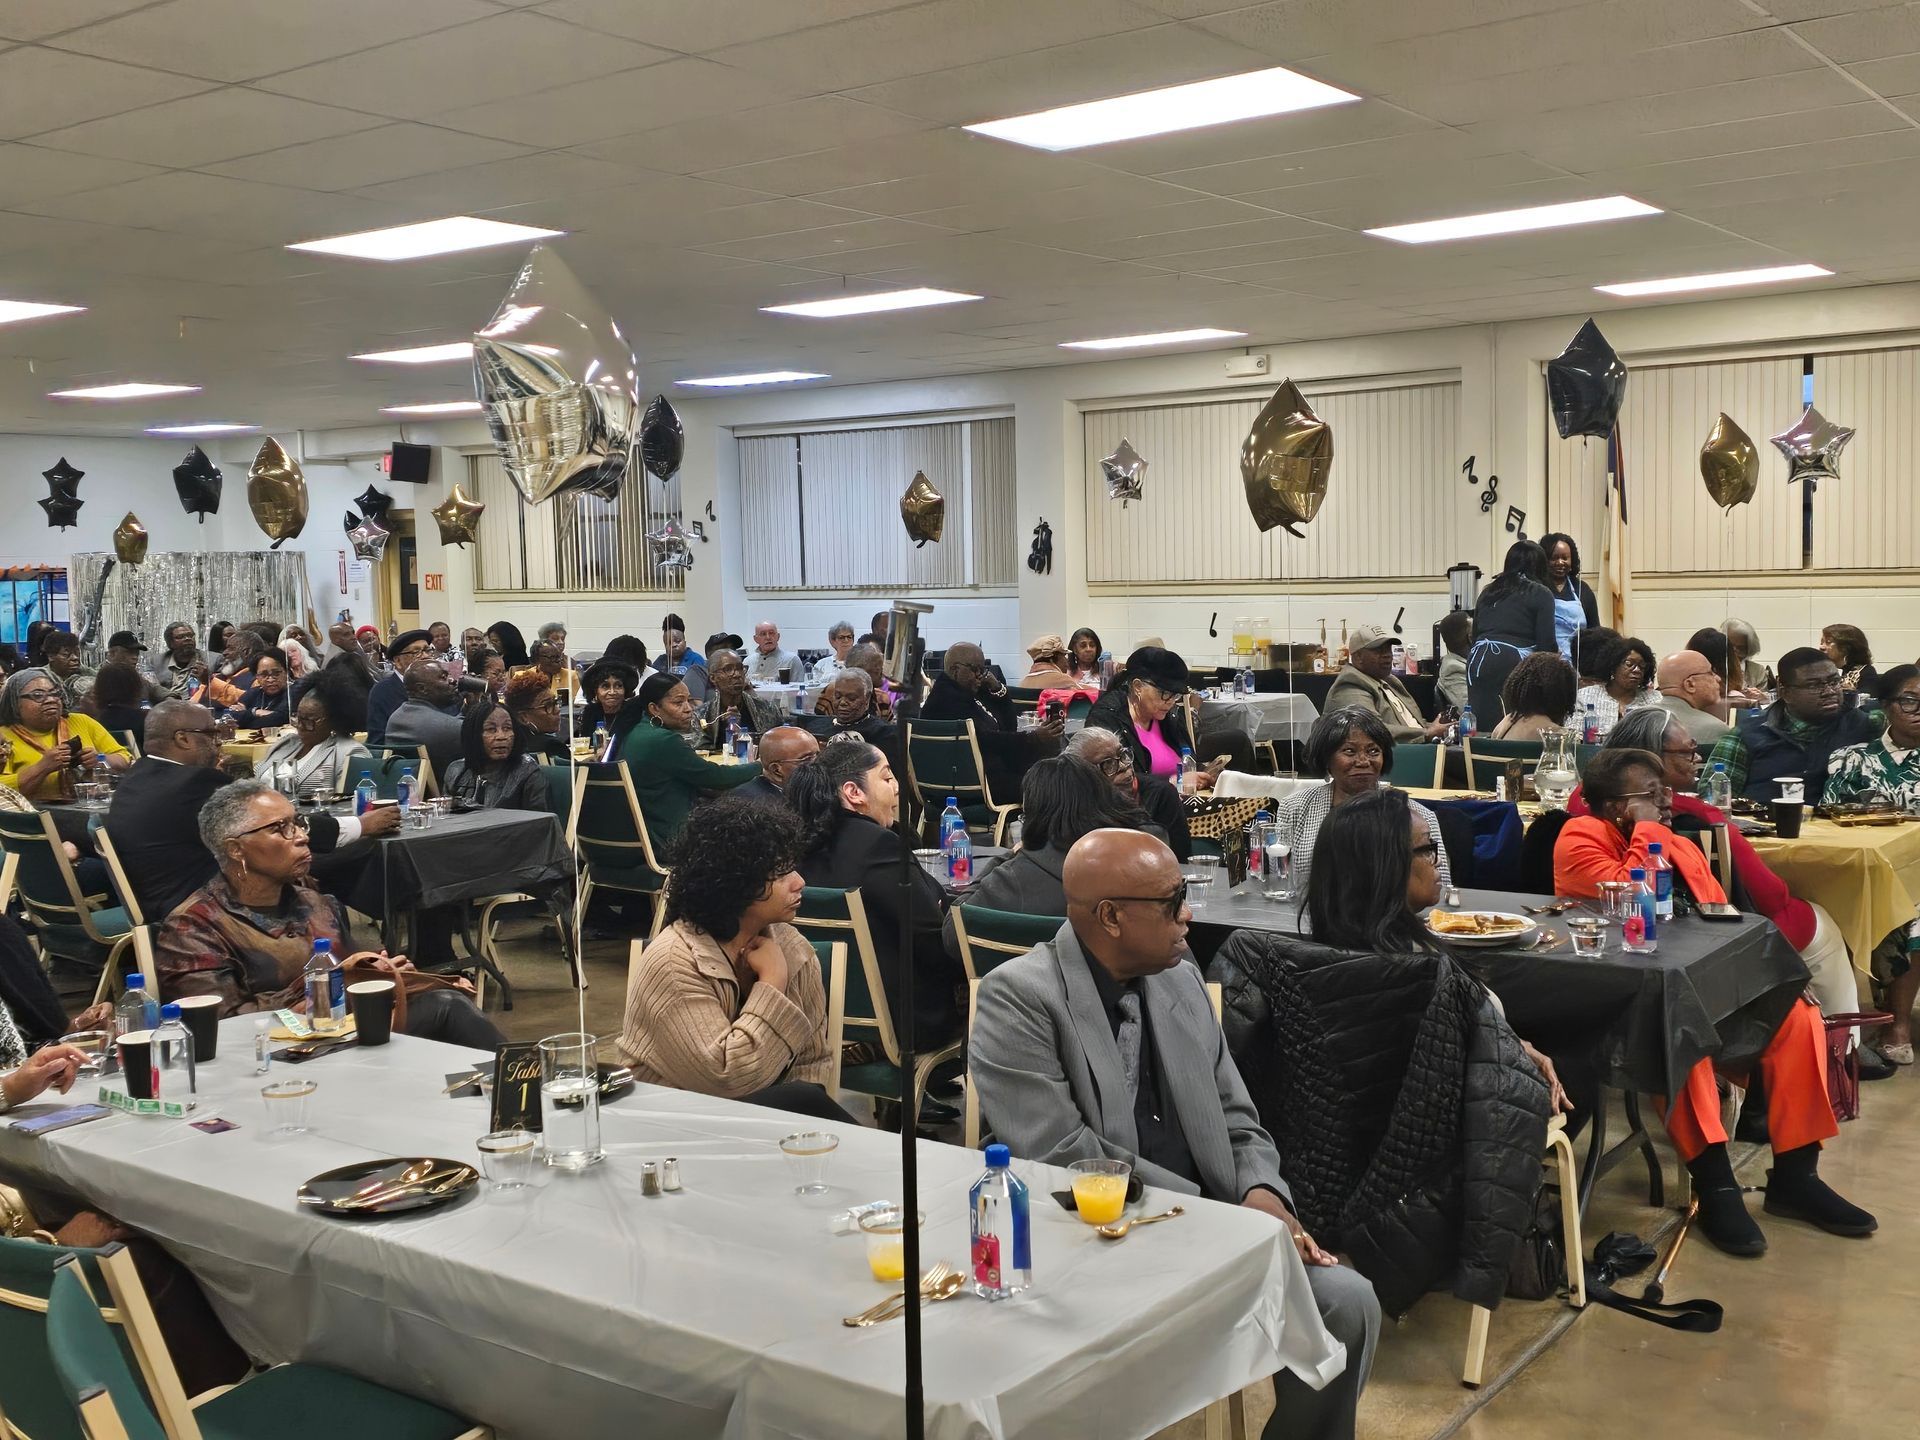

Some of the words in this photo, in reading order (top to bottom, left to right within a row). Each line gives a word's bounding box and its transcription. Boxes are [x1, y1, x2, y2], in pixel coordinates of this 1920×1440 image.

[425, 574, 443, 591] EXIT
[952, 847, 967, 859] FIJI
[1623, 902, 1642, 918] FIJI
[505, 1060, 541, 1082] Tabl
[518, 1082, 529, 1112] 1
